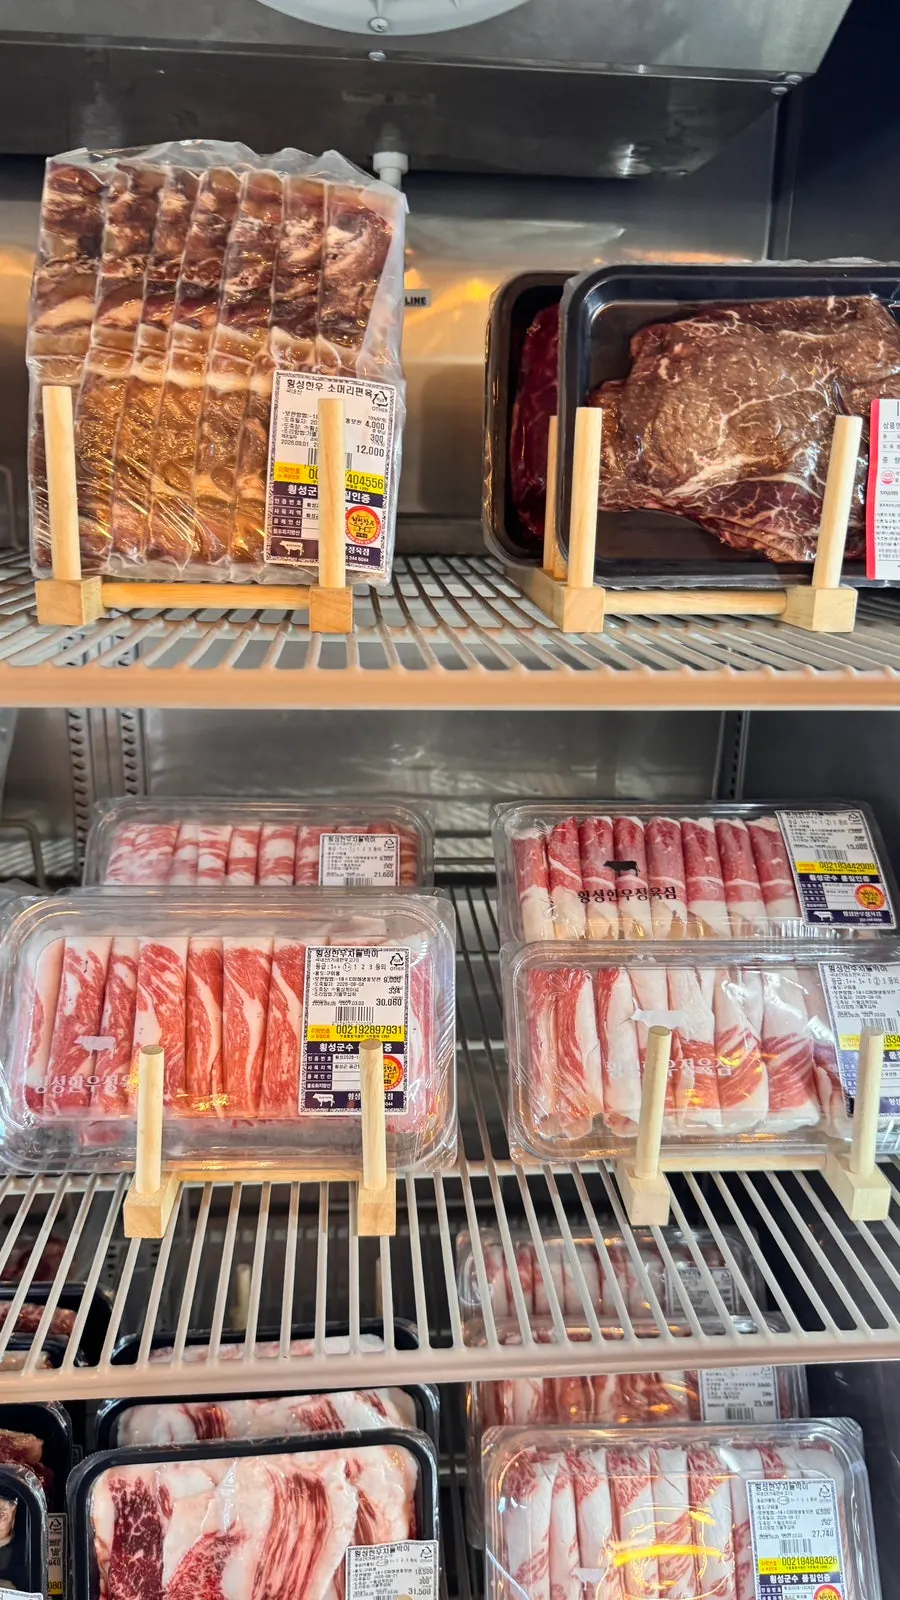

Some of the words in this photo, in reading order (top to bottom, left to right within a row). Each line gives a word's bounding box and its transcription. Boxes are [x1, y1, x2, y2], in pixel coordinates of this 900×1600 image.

[405, 297, 426, 305] LINE
[286, 379, 324, 392] 횡성한우
[327, 385, 373, 399] 소머리편육
[370, 434, 384, 443] 300
[345, 492, 370, 503] 질인증
[578, 886, 676, 904] 횡성한우정육점
[316, 949, 378, 958] 횡성한우차돌박이
[336, 1025, 402, 1035] 002192897931
[319, 1043, 354, 1052] 횡성군수
[782, 1556, 838, 1566] 002194840326
[770, 1575, 798, 1583] 횡성군수
[802, 1574, 831, 1582] 품질인증
